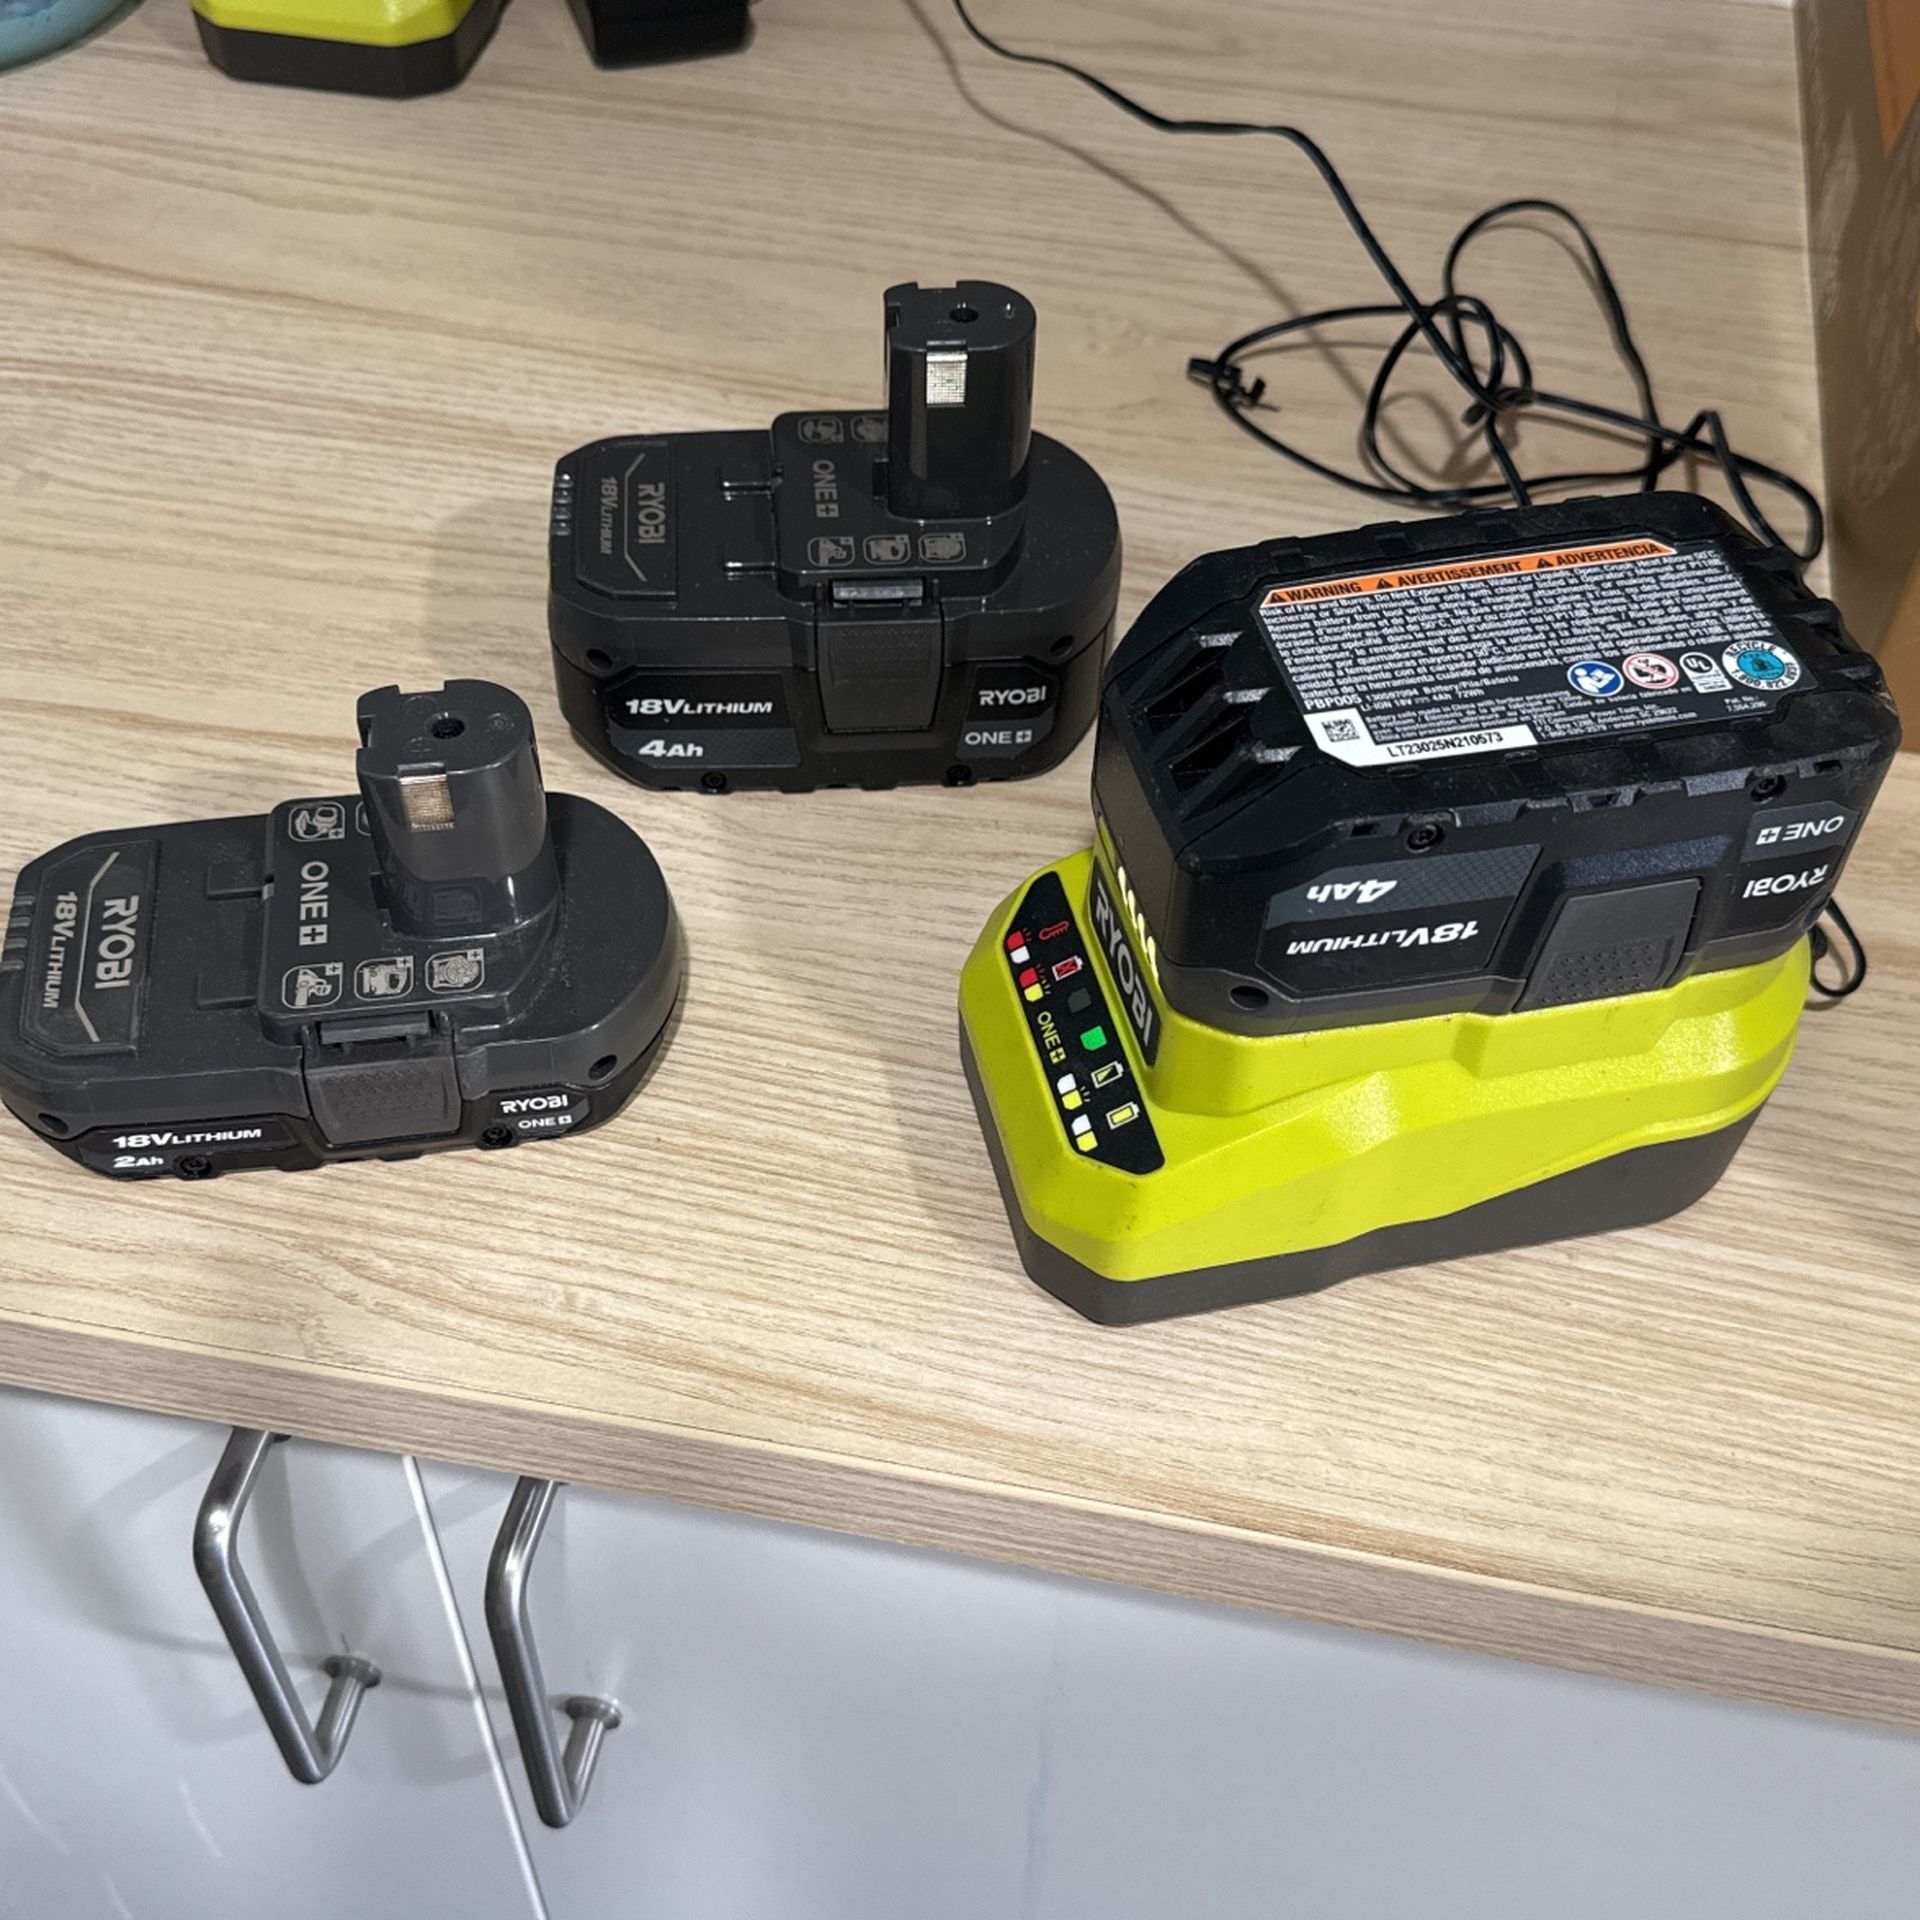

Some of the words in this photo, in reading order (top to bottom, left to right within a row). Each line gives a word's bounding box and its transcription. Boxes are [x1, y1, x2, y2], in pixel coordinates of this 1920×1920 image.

[638, 482, 666, 544] RYOBI
[1555, 544, 1662, 566] ADVERTENCIA
[1397, 562, 1523, 587] AVERTISSEMENT
[1285, 583, 1363, 601] WARNING
[1685, 657, 1711, 671] UL
[979, 686, 1047, 707] RYOBI
[1304, 693, 1362, 710] PBP005
[639, 739, 704, 759] 4Ah
[1385, 730, 1505, 758] LT23025N210573
[1306, 879, 1398, 903] 4Ah
[1743, 863, 1829, 900] RYOBI
[95, 895, 139, 990] RYOBI
[1096, 879, 1152, 1046] RYOBI
[500, 1095, 568, 1114] RYOBI
[113, 1154, 165, 1169] 2Ah
